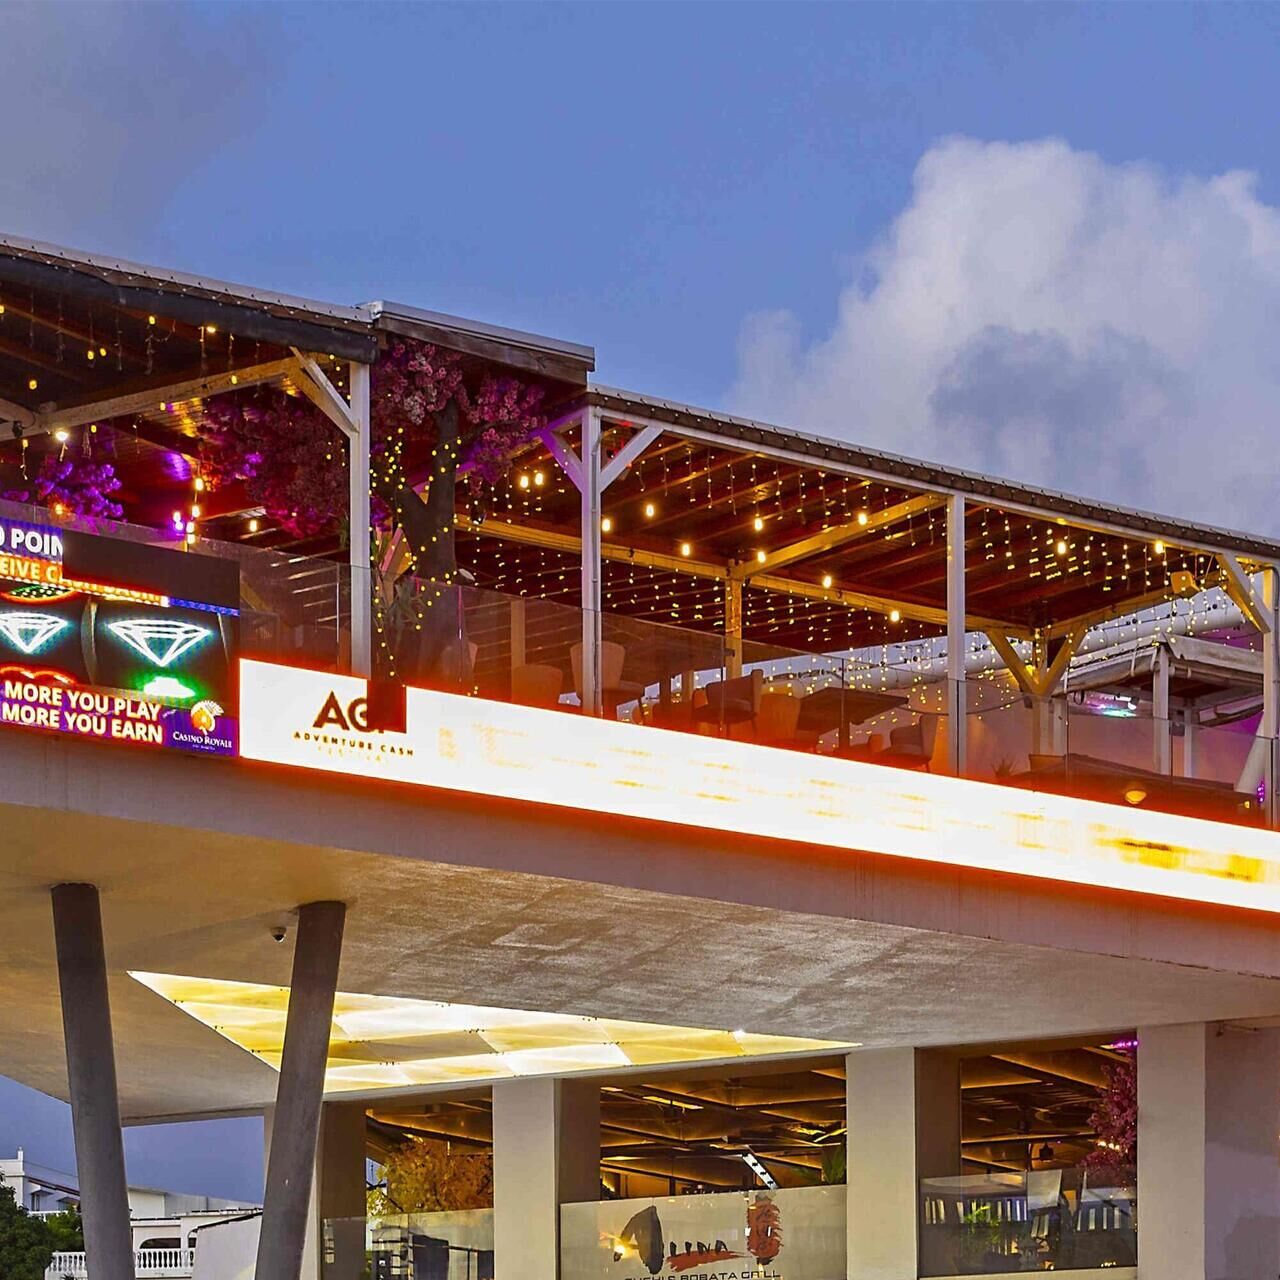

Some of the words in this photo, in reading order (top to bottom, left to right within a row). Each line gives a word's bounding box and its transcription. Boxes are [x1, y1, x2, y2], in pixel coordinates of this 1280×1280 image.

[5, 680, 63, 707] MORE
[67, 690, 109, 714] YOU
[114, 696, 162, 721] PLAY
[2, 701, 61, 729] MORE
[64, 711, 106, 735] YOU
[111, 718, 163, 745] EARN
[173, 731, 203, 744] CASINO
[204, 736, 232, 748] ROYALE
[293, 731, 373, 750] ADVENTURE
[380, 744, 414, 757] CASH
[741, 1269, 781, 1280] GRILL
